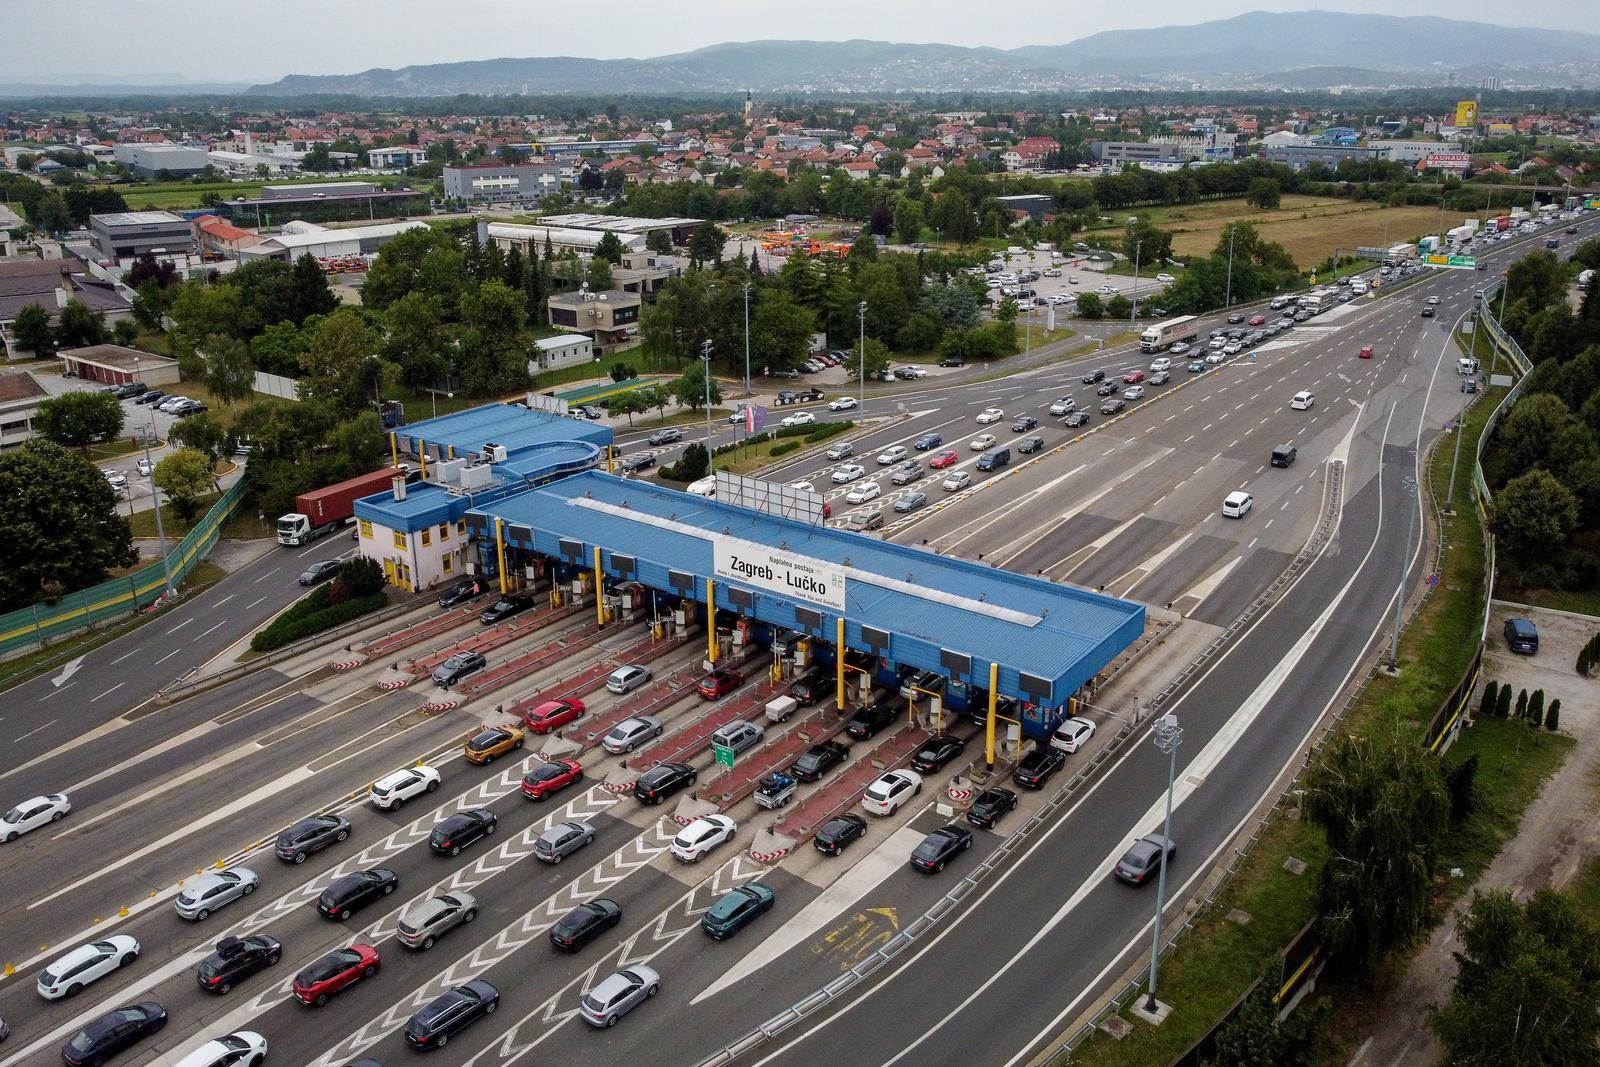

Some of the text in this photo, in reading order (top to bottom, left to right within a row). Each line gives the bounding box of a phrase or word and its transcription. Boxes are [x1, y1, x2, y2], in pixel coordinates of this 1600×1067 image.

[731, 556, 773, 580] Zagreb
[787, 571, 826, 595] Lučko
[769, 556, 814, 574] Naplatna postaja
